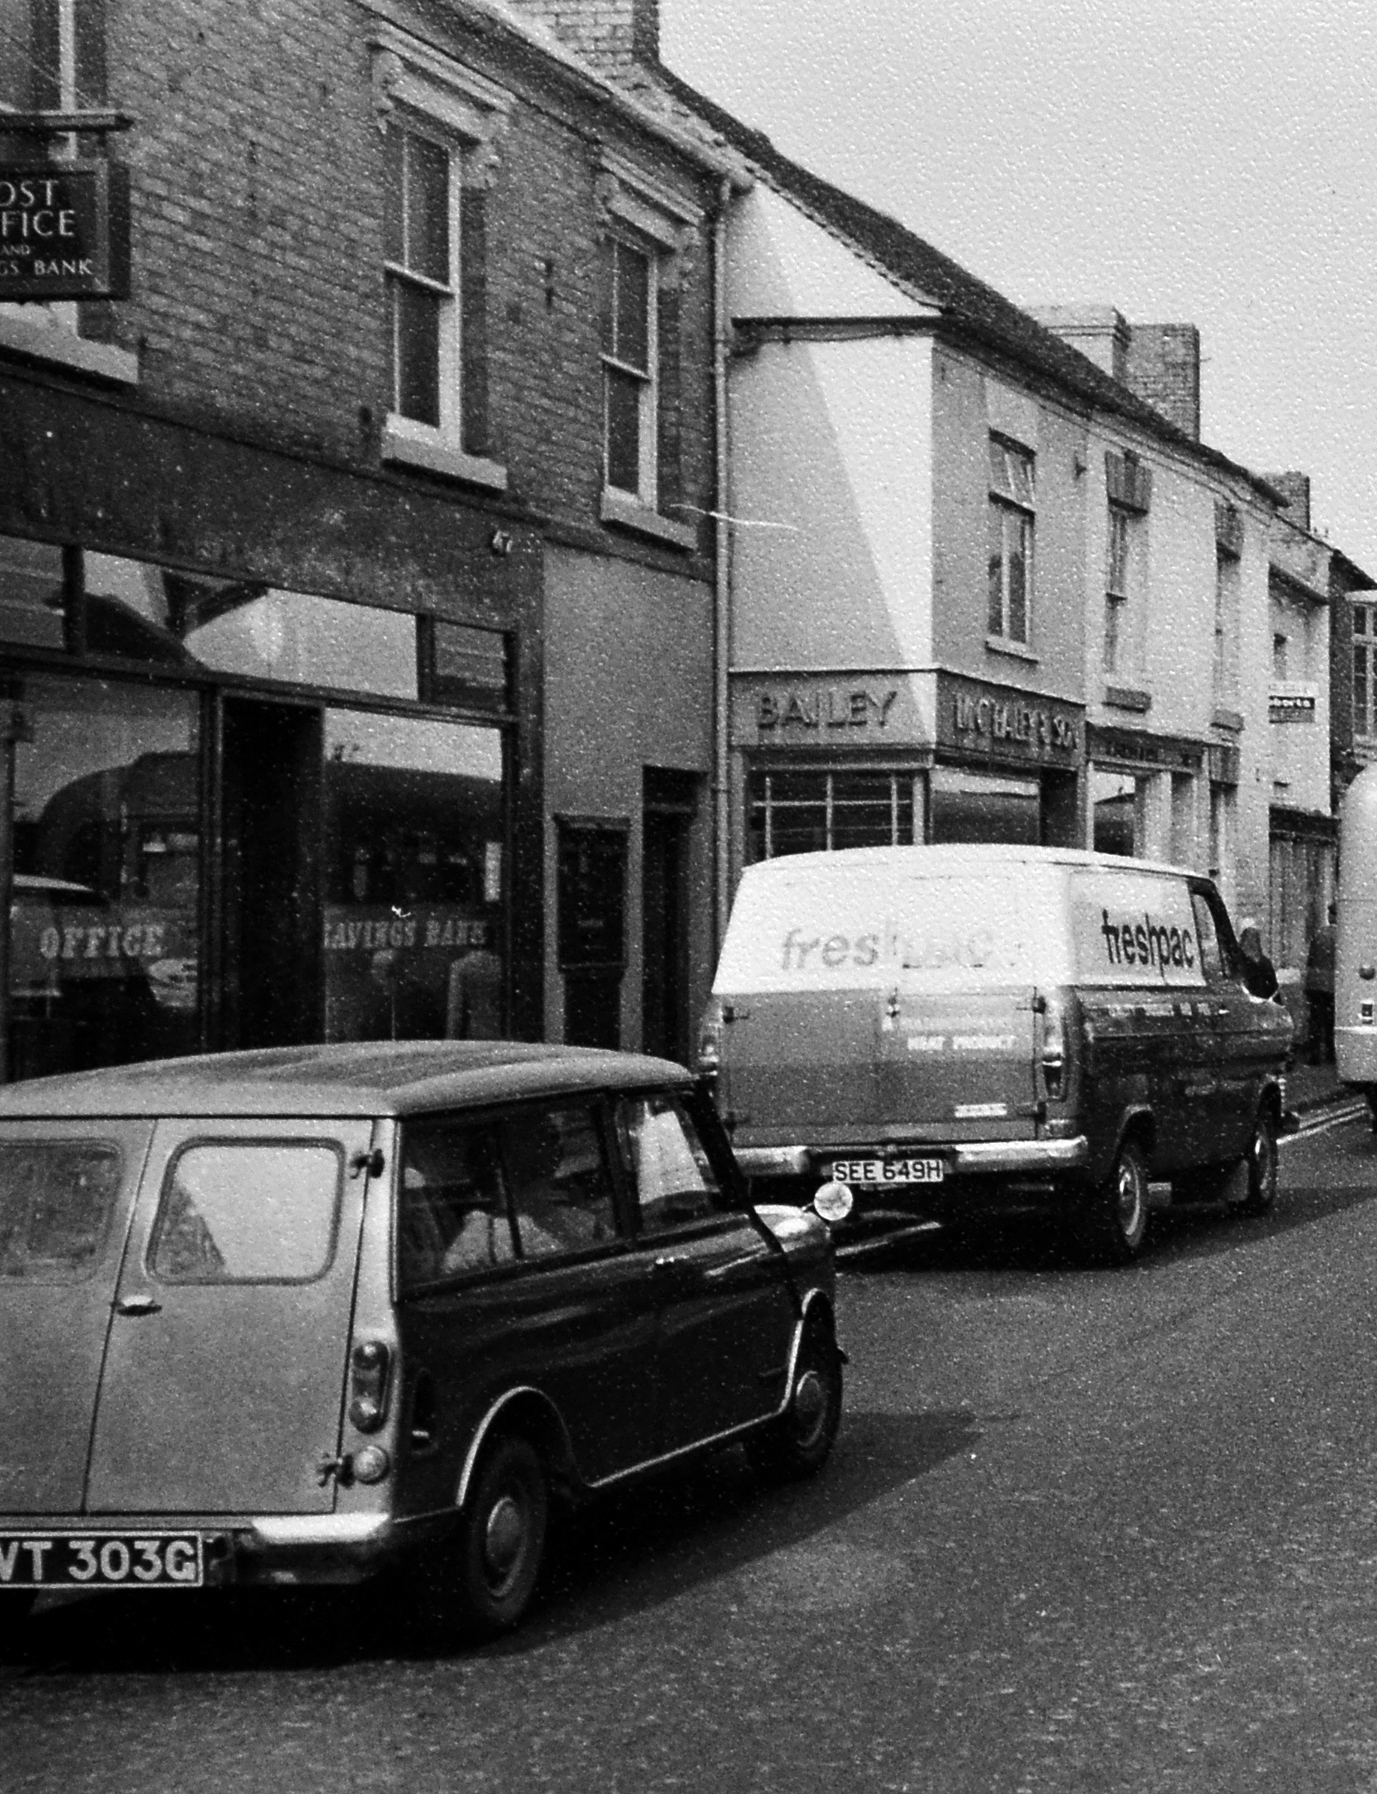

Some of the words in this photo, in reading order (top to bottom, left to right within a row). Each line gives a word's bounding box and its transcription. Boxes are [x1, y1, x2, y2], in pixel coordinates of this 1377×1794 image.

[34, 258, 93, 275] BANK
[757, 688, 897, 730] BAILEY
[40, 924, 164, 958] OFFICE
[424, 920, 486, 947] BANK
[1102, 909, 1194, 983] freshpac
[835, 1161, 877, 1181] SEE
[883, 1160, 941, 1180] 649H
[68, 1540, 196, 1581] 303G
